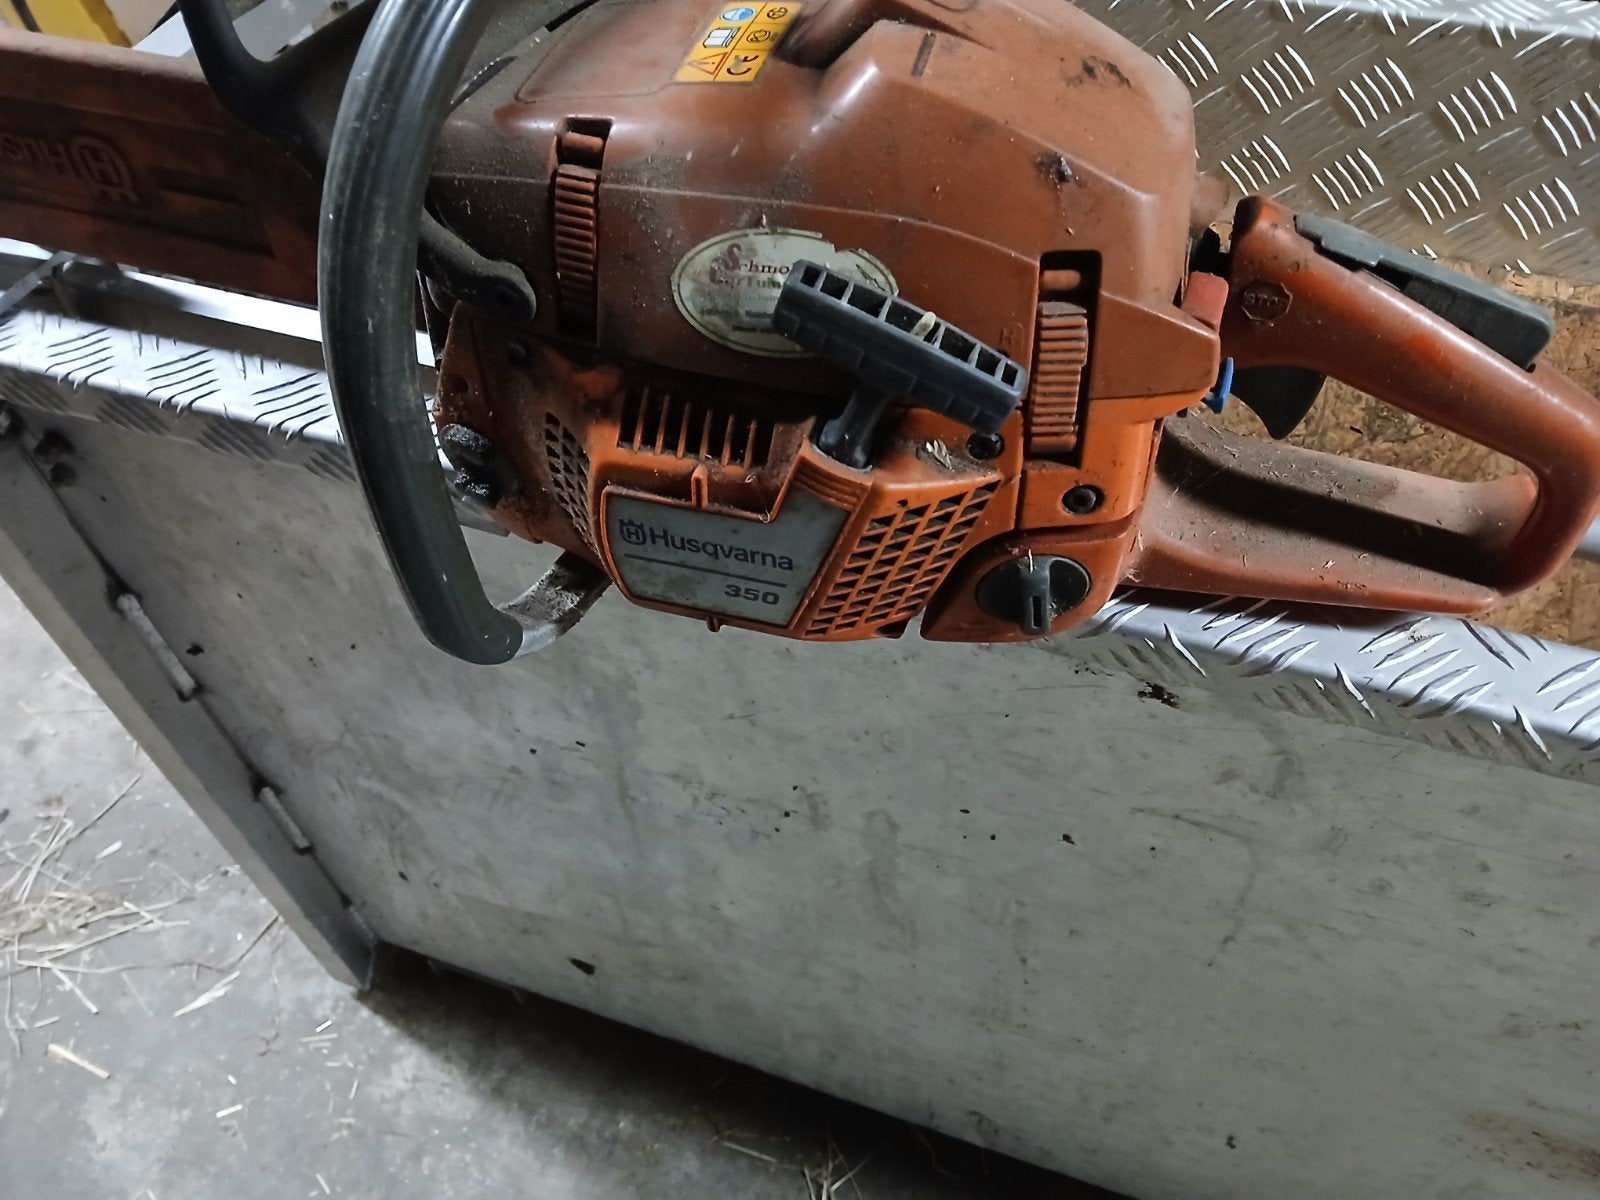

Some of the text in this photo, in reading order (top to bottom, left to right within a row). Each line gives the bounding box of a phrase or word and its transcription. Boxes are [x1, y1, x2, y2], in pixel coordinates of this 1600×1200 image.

[0, 131, 80, 177] Hus
[724, 243, 790, 274] Schmo
[650, 527, 794, 571] Husqvarna
[724, 584, 780, 606] 350
